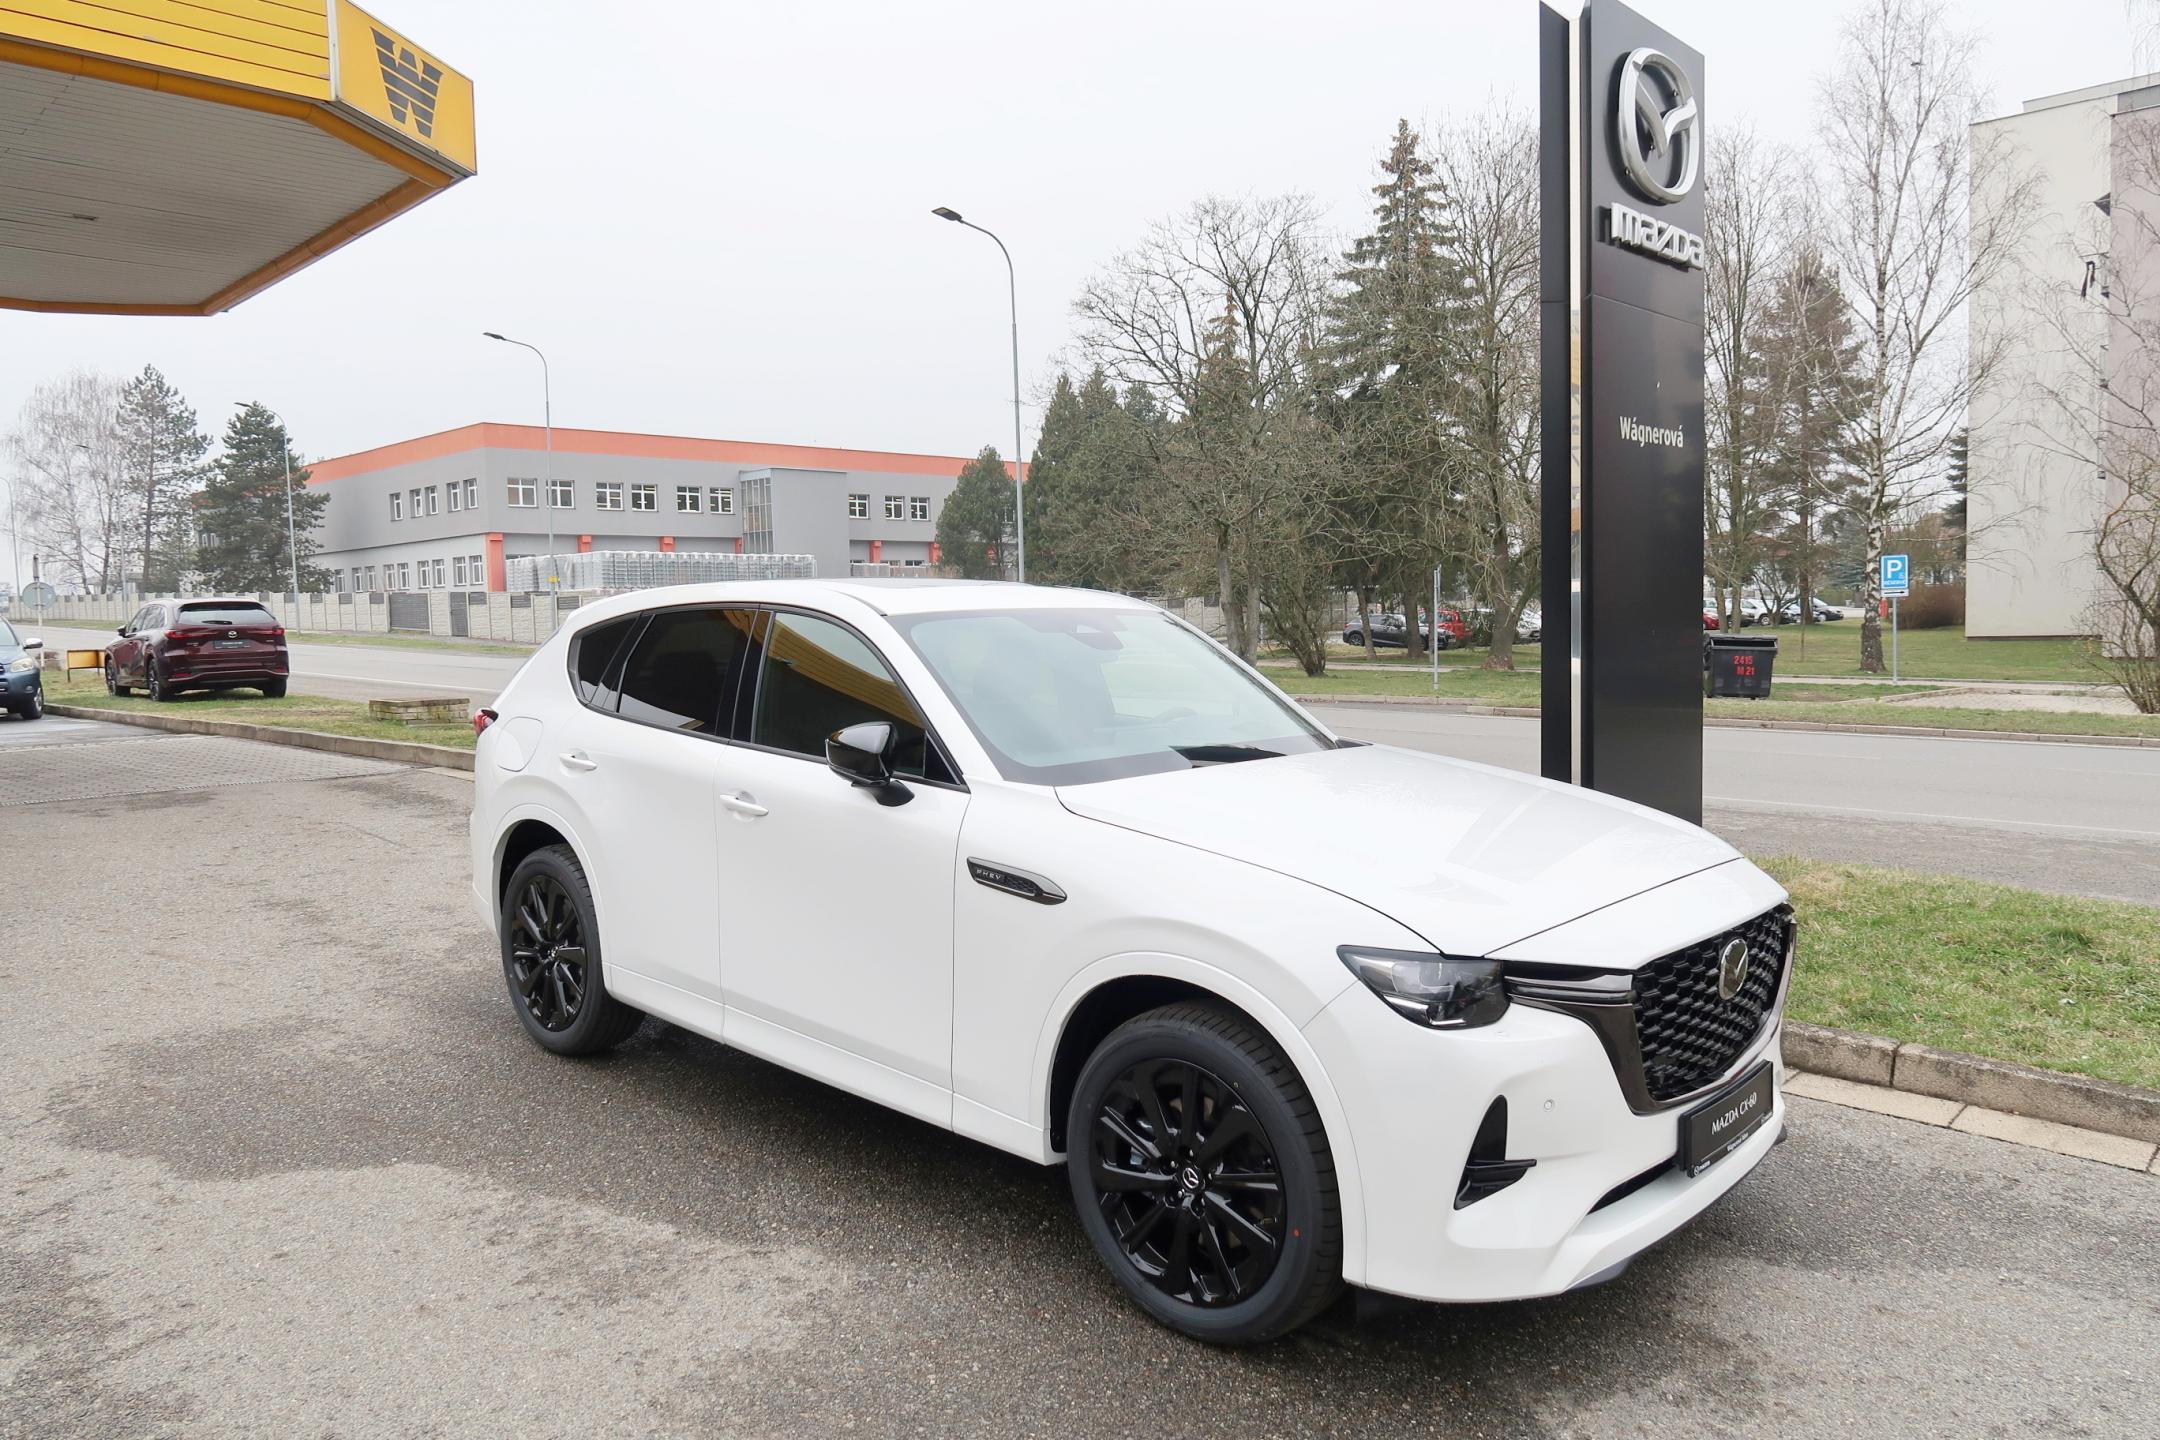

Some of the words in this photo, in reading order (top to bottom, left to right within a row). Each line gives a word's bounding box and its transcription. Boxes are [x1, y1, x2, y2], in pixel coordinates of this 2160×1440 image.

[1619, 415, 1684, 448] Wágnerová
[1887, 559, 1902, 579] P
[1711, 1107, 1739, 1136] MAZDA
